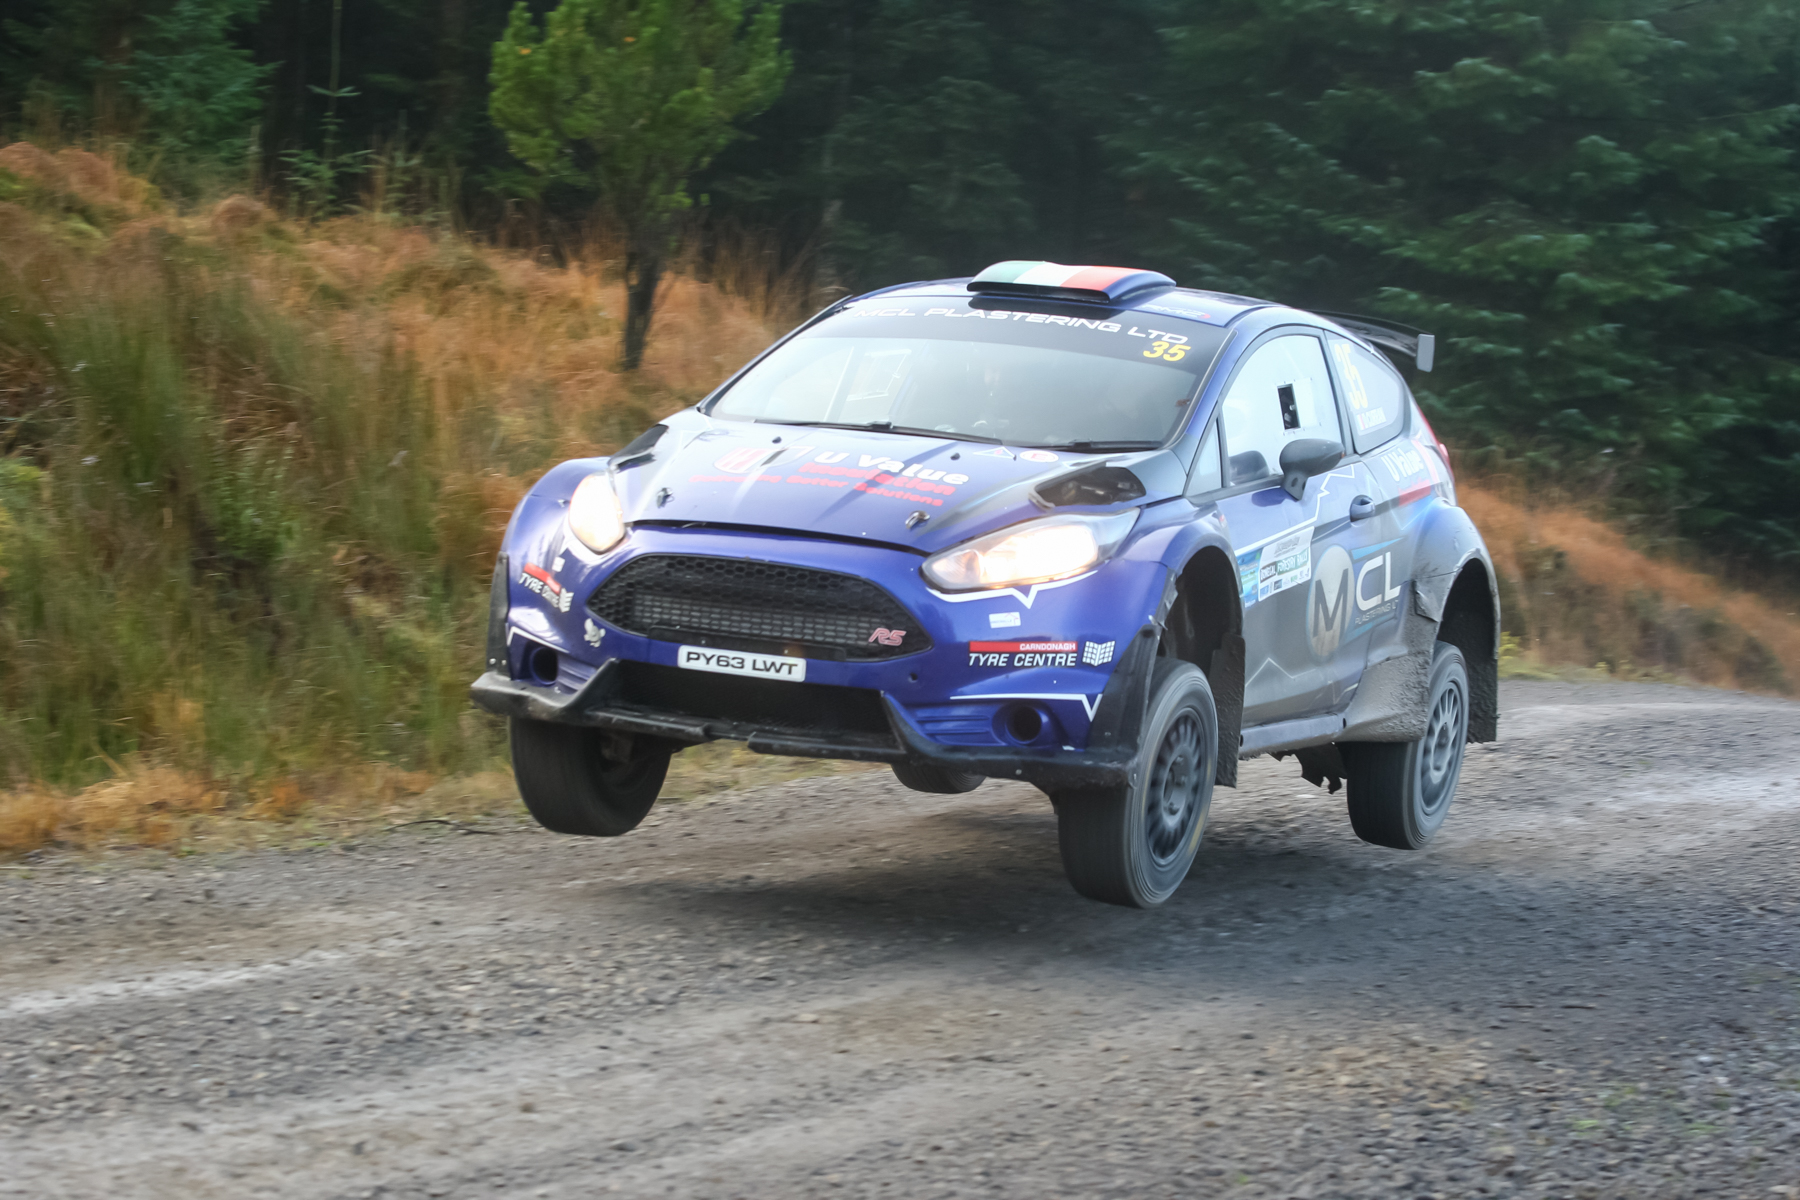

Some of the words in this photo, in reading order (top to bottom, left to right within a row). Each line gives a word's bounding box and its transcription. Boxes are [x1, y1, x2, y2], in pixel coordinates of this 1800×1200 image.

[853, 307, 916, 318] MCL
[923, 307, 1122, 333] PLASTERING
[1127, 326, 1188, 344] LTD
[1142, 340, 1191, 362] 35
[813, 451, 850, 465] U
[857, 454, 969, 485] Value
[518, 572, 545, 594] TYRE
[868, 627, 907, 646] RS
[1019, 643, 1076, 651] CARNDONAGH
[685, 651, 745, 669] PY63
[751, 659, 798, 676] LWT
[968, 653, 1008, 667] TYRE
[1013, 653, 1077, 667] CENTRE
